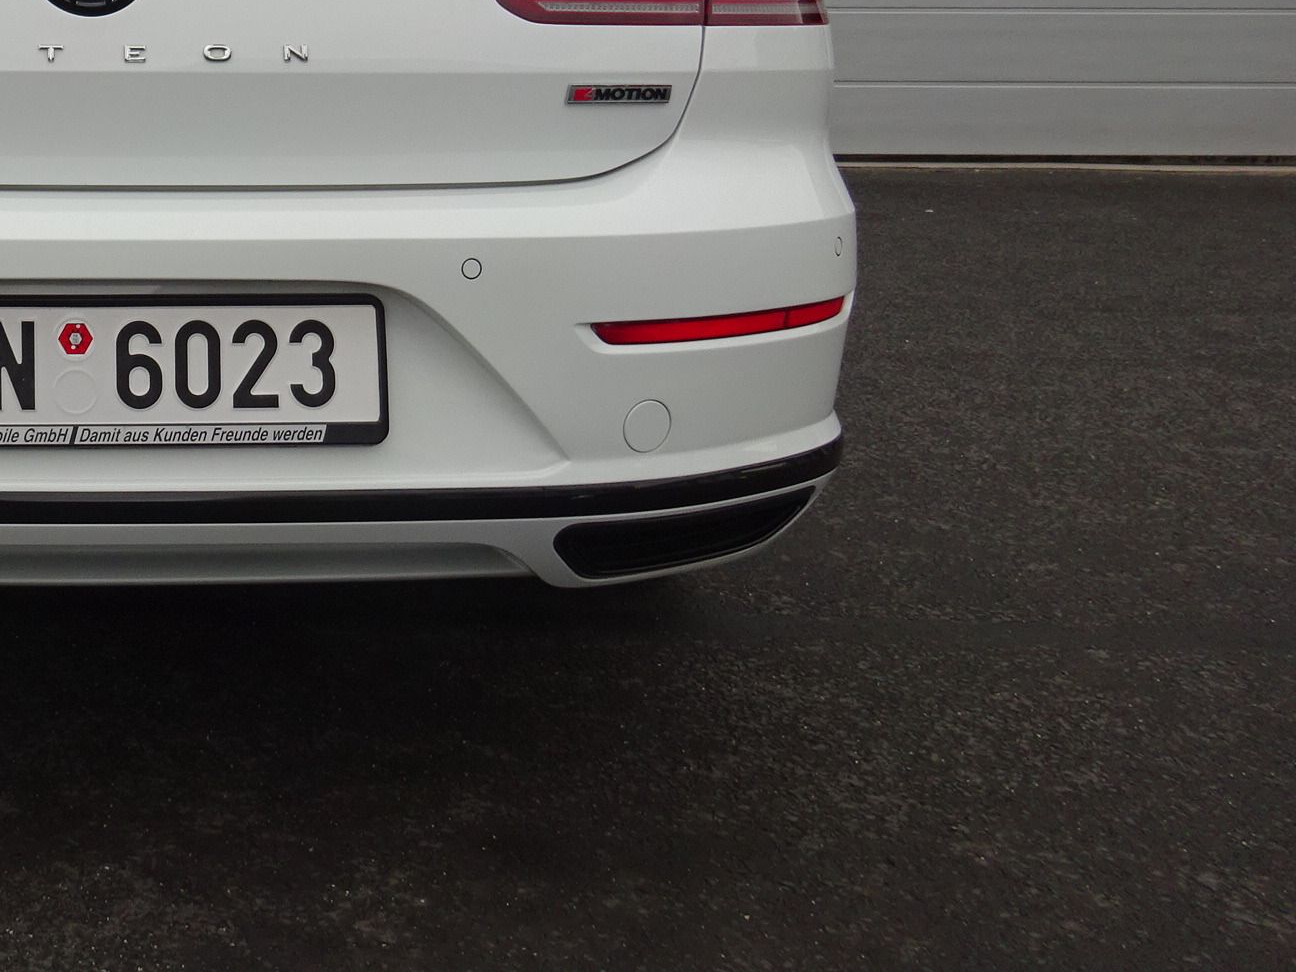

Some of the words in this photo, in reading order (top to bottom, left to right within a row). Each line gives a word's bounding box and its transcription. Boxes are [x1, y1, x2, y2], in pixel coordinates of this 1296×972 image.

[115, 319, 336, 409] 6023
[23, 428, 69, 443] GmbH
[79, 428, 121, 443] Damit
[123, 431, 149, 443] aus
[153, 427, 207, 442] Kunden
[211, 426, 269, 442] Freunde
[272, 426, 323, 442] werden
